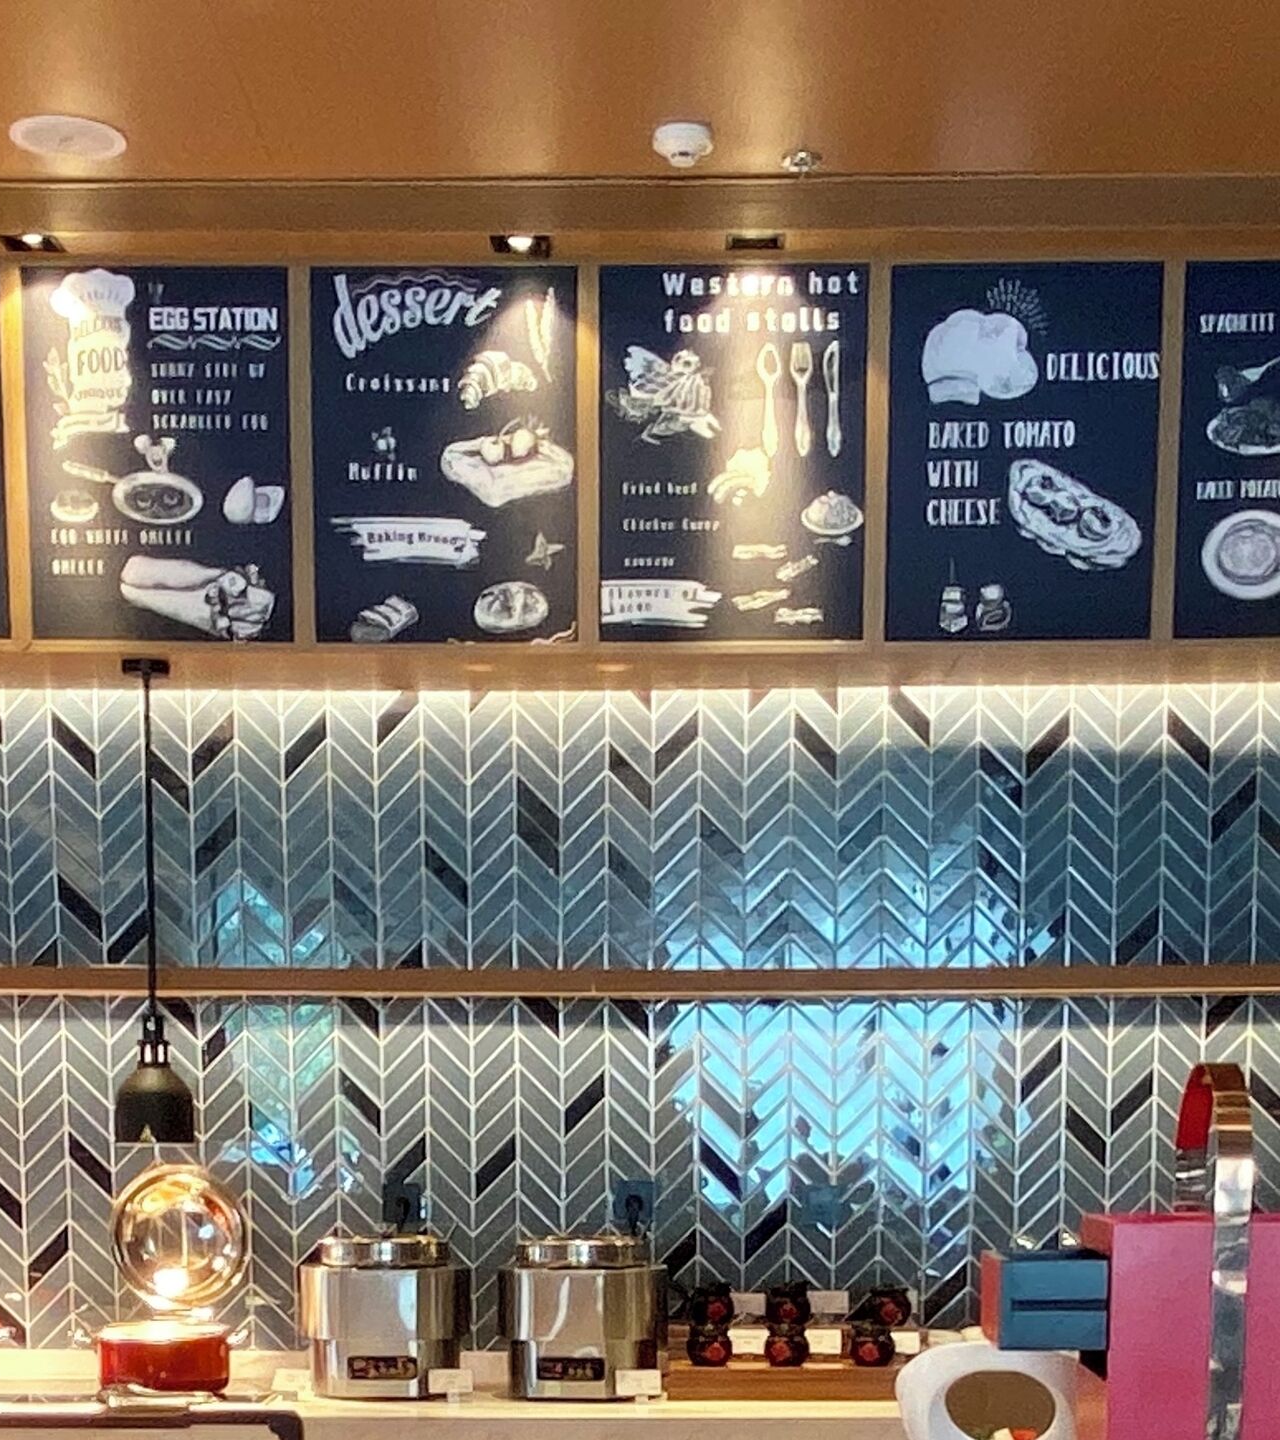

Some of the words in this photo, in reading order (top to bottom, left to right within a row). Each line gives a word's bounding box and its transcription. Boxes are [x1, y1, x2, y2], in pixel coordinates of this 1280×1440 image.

[662, 271, 794, 297] Western
[808, 270, 859, 295] hot
[149, 308, 189, 330] EGG
[192, 307, 278, 331] STATION
[332, 274, 502, 359] dessert
[664, 308, 731, 334] food
[77, 347, 125, 376] FOOD
[1046, 352, 1160, 381] DELICIOUS
[346, 373, 450, 393] Croissant
[928, 421, 989, 449] BAKED
[1003, 421, 1076, 448] TOMATO
[348, 462, 419, 481] Muffin
[927, 460, 979, 487] WITH
[926, 498, 1000, 526] CHEESE
